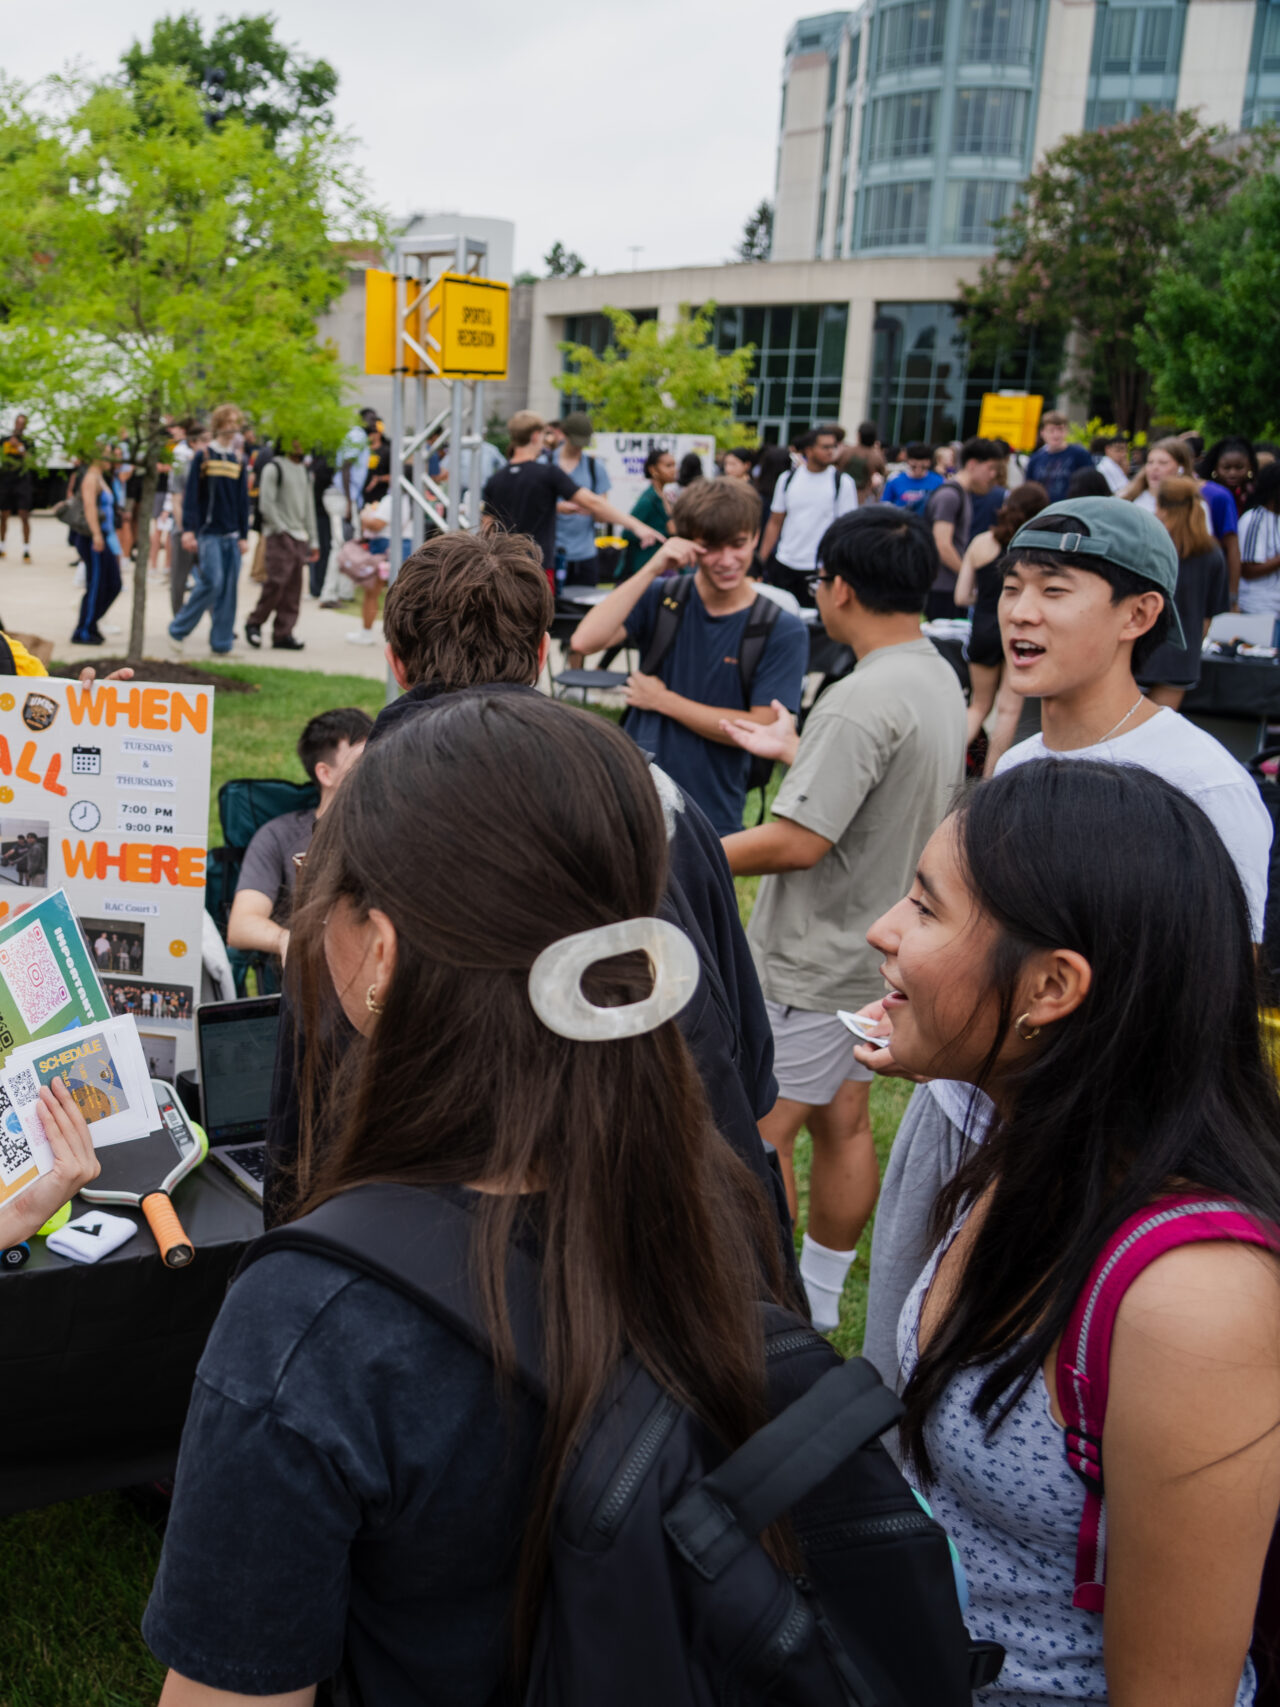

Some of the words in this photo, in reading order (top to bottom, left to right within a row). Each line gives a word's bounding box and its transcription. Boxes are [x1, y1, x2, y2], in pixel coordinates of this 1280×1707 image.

[66, 685, 208, 734] WHEN
[123, 741, 174, 752] TUESDAYS
[142, 760, 150, 769] &
[116, 775, 174, 788] THURSDAYS
[122, 804, 147, 814] 7:00
[155, 807, 173, 817] PM
[125, 822, 151, 832] 9:00
[155, 825, 173, 834] PM
[62, 838, 207, 887] WHERE
[104, 902, 123, 912] RAC
[125, 903, 151, 913] Court
[54, 927, 95, 1018] IMPORTANT
[39, 1038, 103, 1073] SCHEDULE
